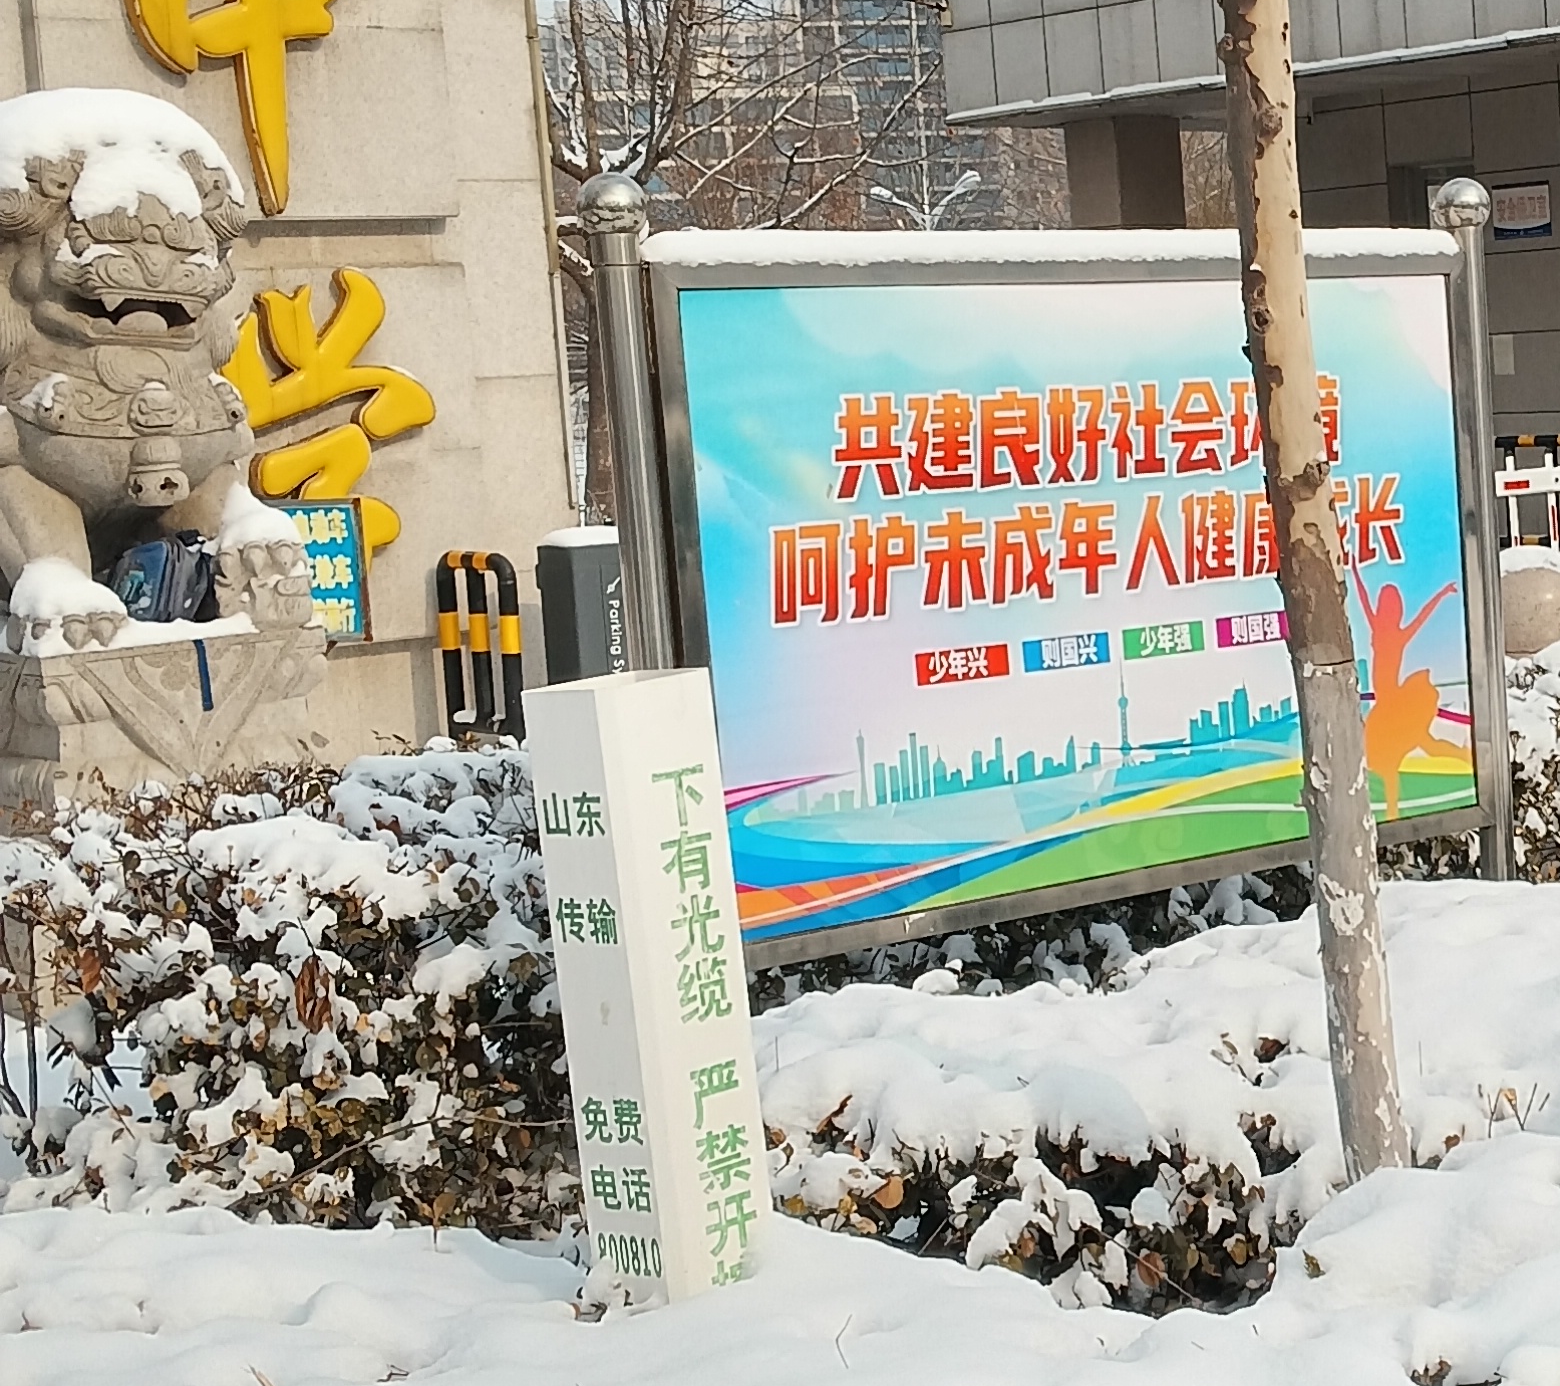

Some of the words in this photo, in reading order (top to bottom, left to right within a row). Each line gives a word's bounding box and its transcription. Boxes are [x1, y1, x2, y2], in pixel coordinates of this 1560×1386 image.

[772, 475, 1404, 625] 呵护未成年人健康长
[608, 600, 623, 656] Parking
[929, 644, 989, 684] 少年兴
[1041, 633, 1099, 669] 则国兴
[1139, 622, 1192, 657] 少年强
[1230, 613, 1282, 645] 则国强
[541, 790, 607, 838] 山东
[651, 763, 733, 1024] 下有光缆
[555, 897, 619, 946] 传输
[580, 1095, 645, 1146] 免费
[590, 1163, 652, 1214] 电话
